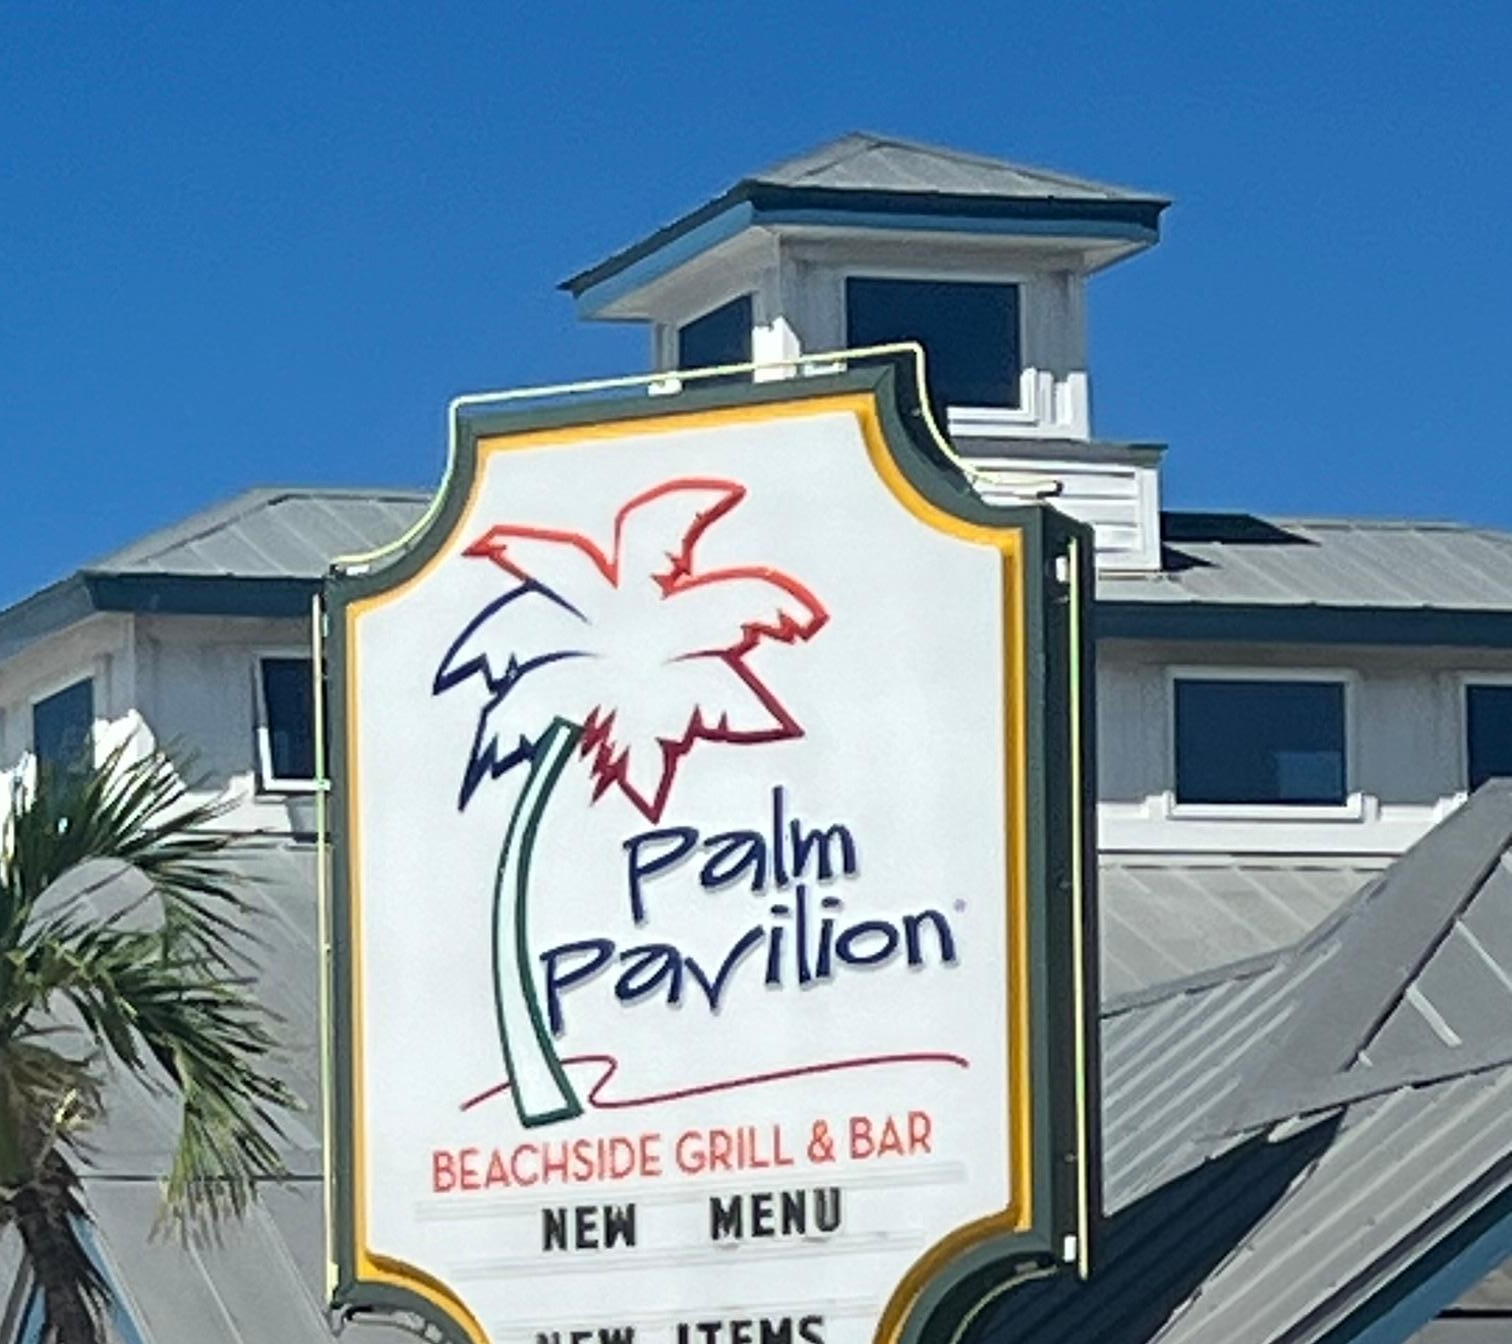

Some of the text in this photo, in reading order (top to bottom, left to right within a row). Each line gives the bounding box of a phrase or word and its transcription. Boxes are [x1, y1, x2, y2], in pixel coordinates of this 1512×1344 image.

[432, 1110, 933, 1193] BEACHSIDE GRILL & BAR
[541, 1186, 843, 1252] NEW MENU
